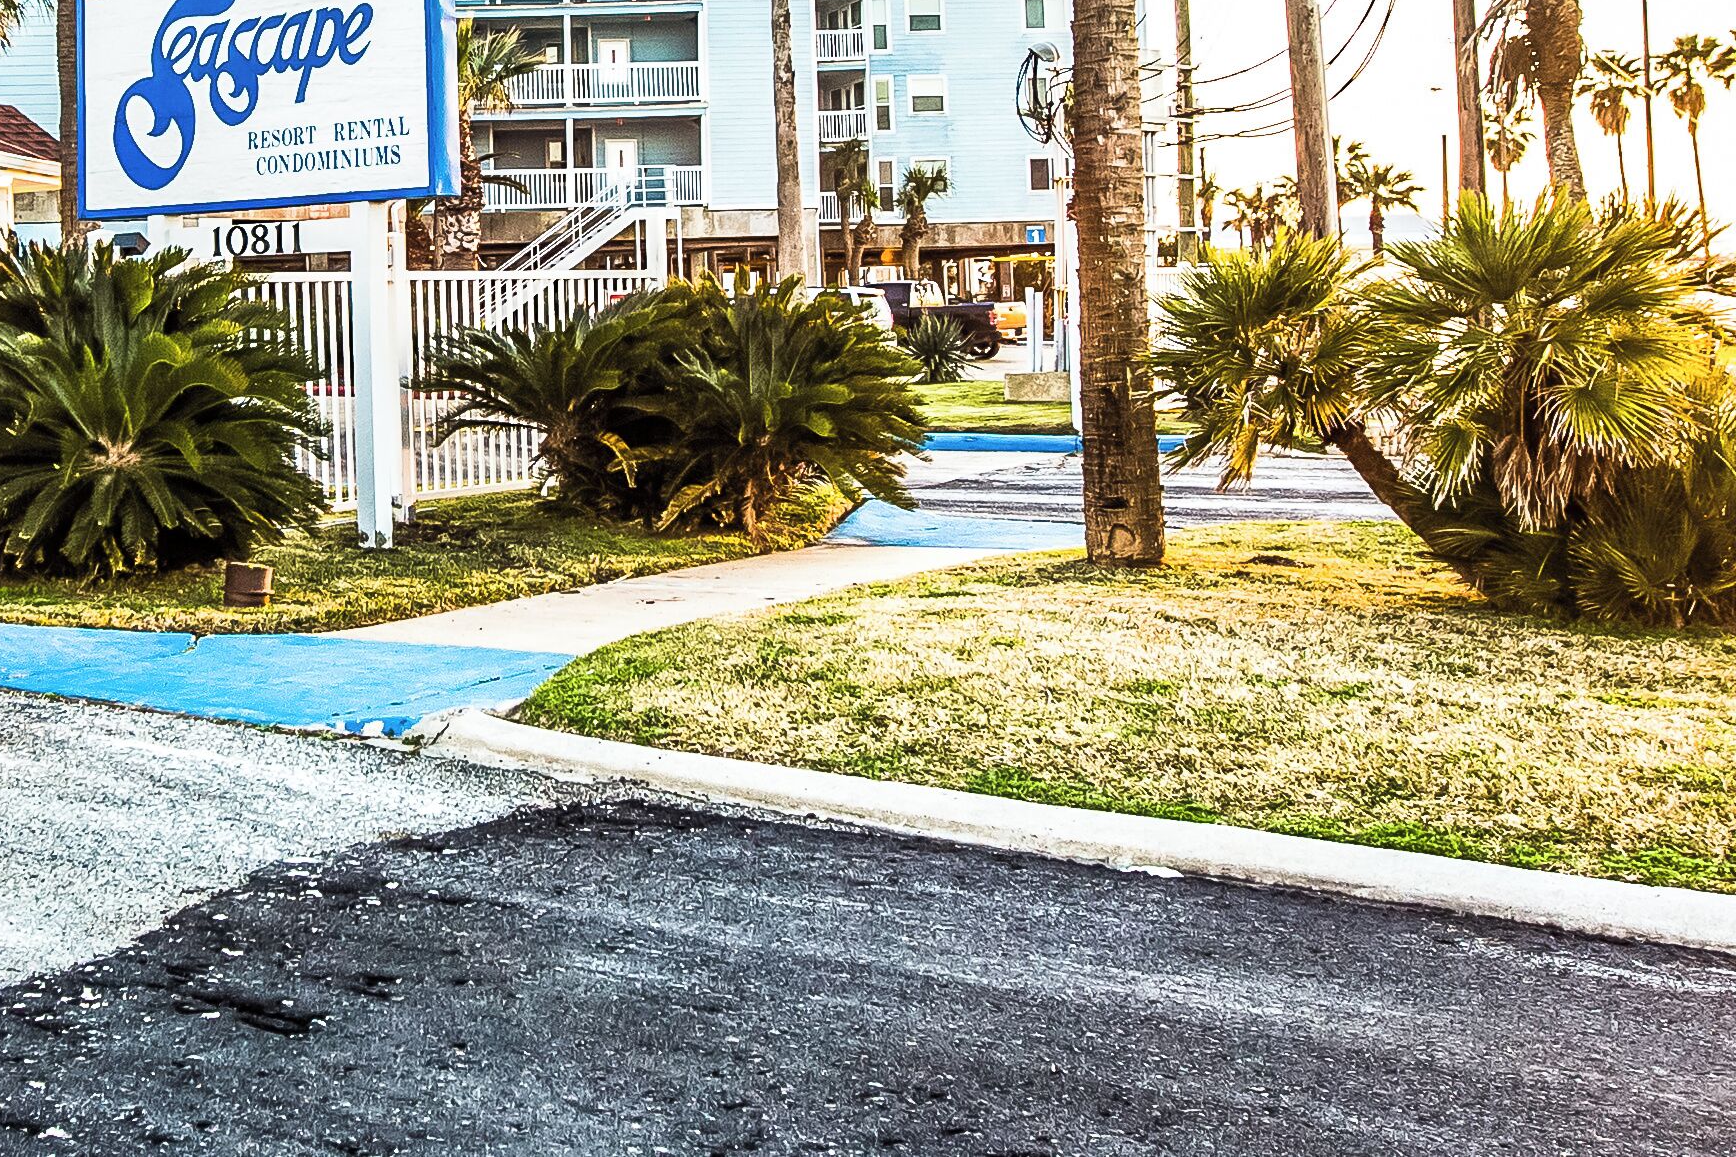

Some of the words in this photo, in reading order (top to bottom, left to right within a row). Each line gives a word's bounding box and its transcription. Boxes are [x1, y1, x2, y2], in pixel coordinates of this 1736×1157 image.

[247, 125, 317, 151] RESORT
[334, 115, 411, 143] RENTAL
[256, 144, 402, 176] CONDOMINIUMS
[212, 221, 302, 257] 10811
